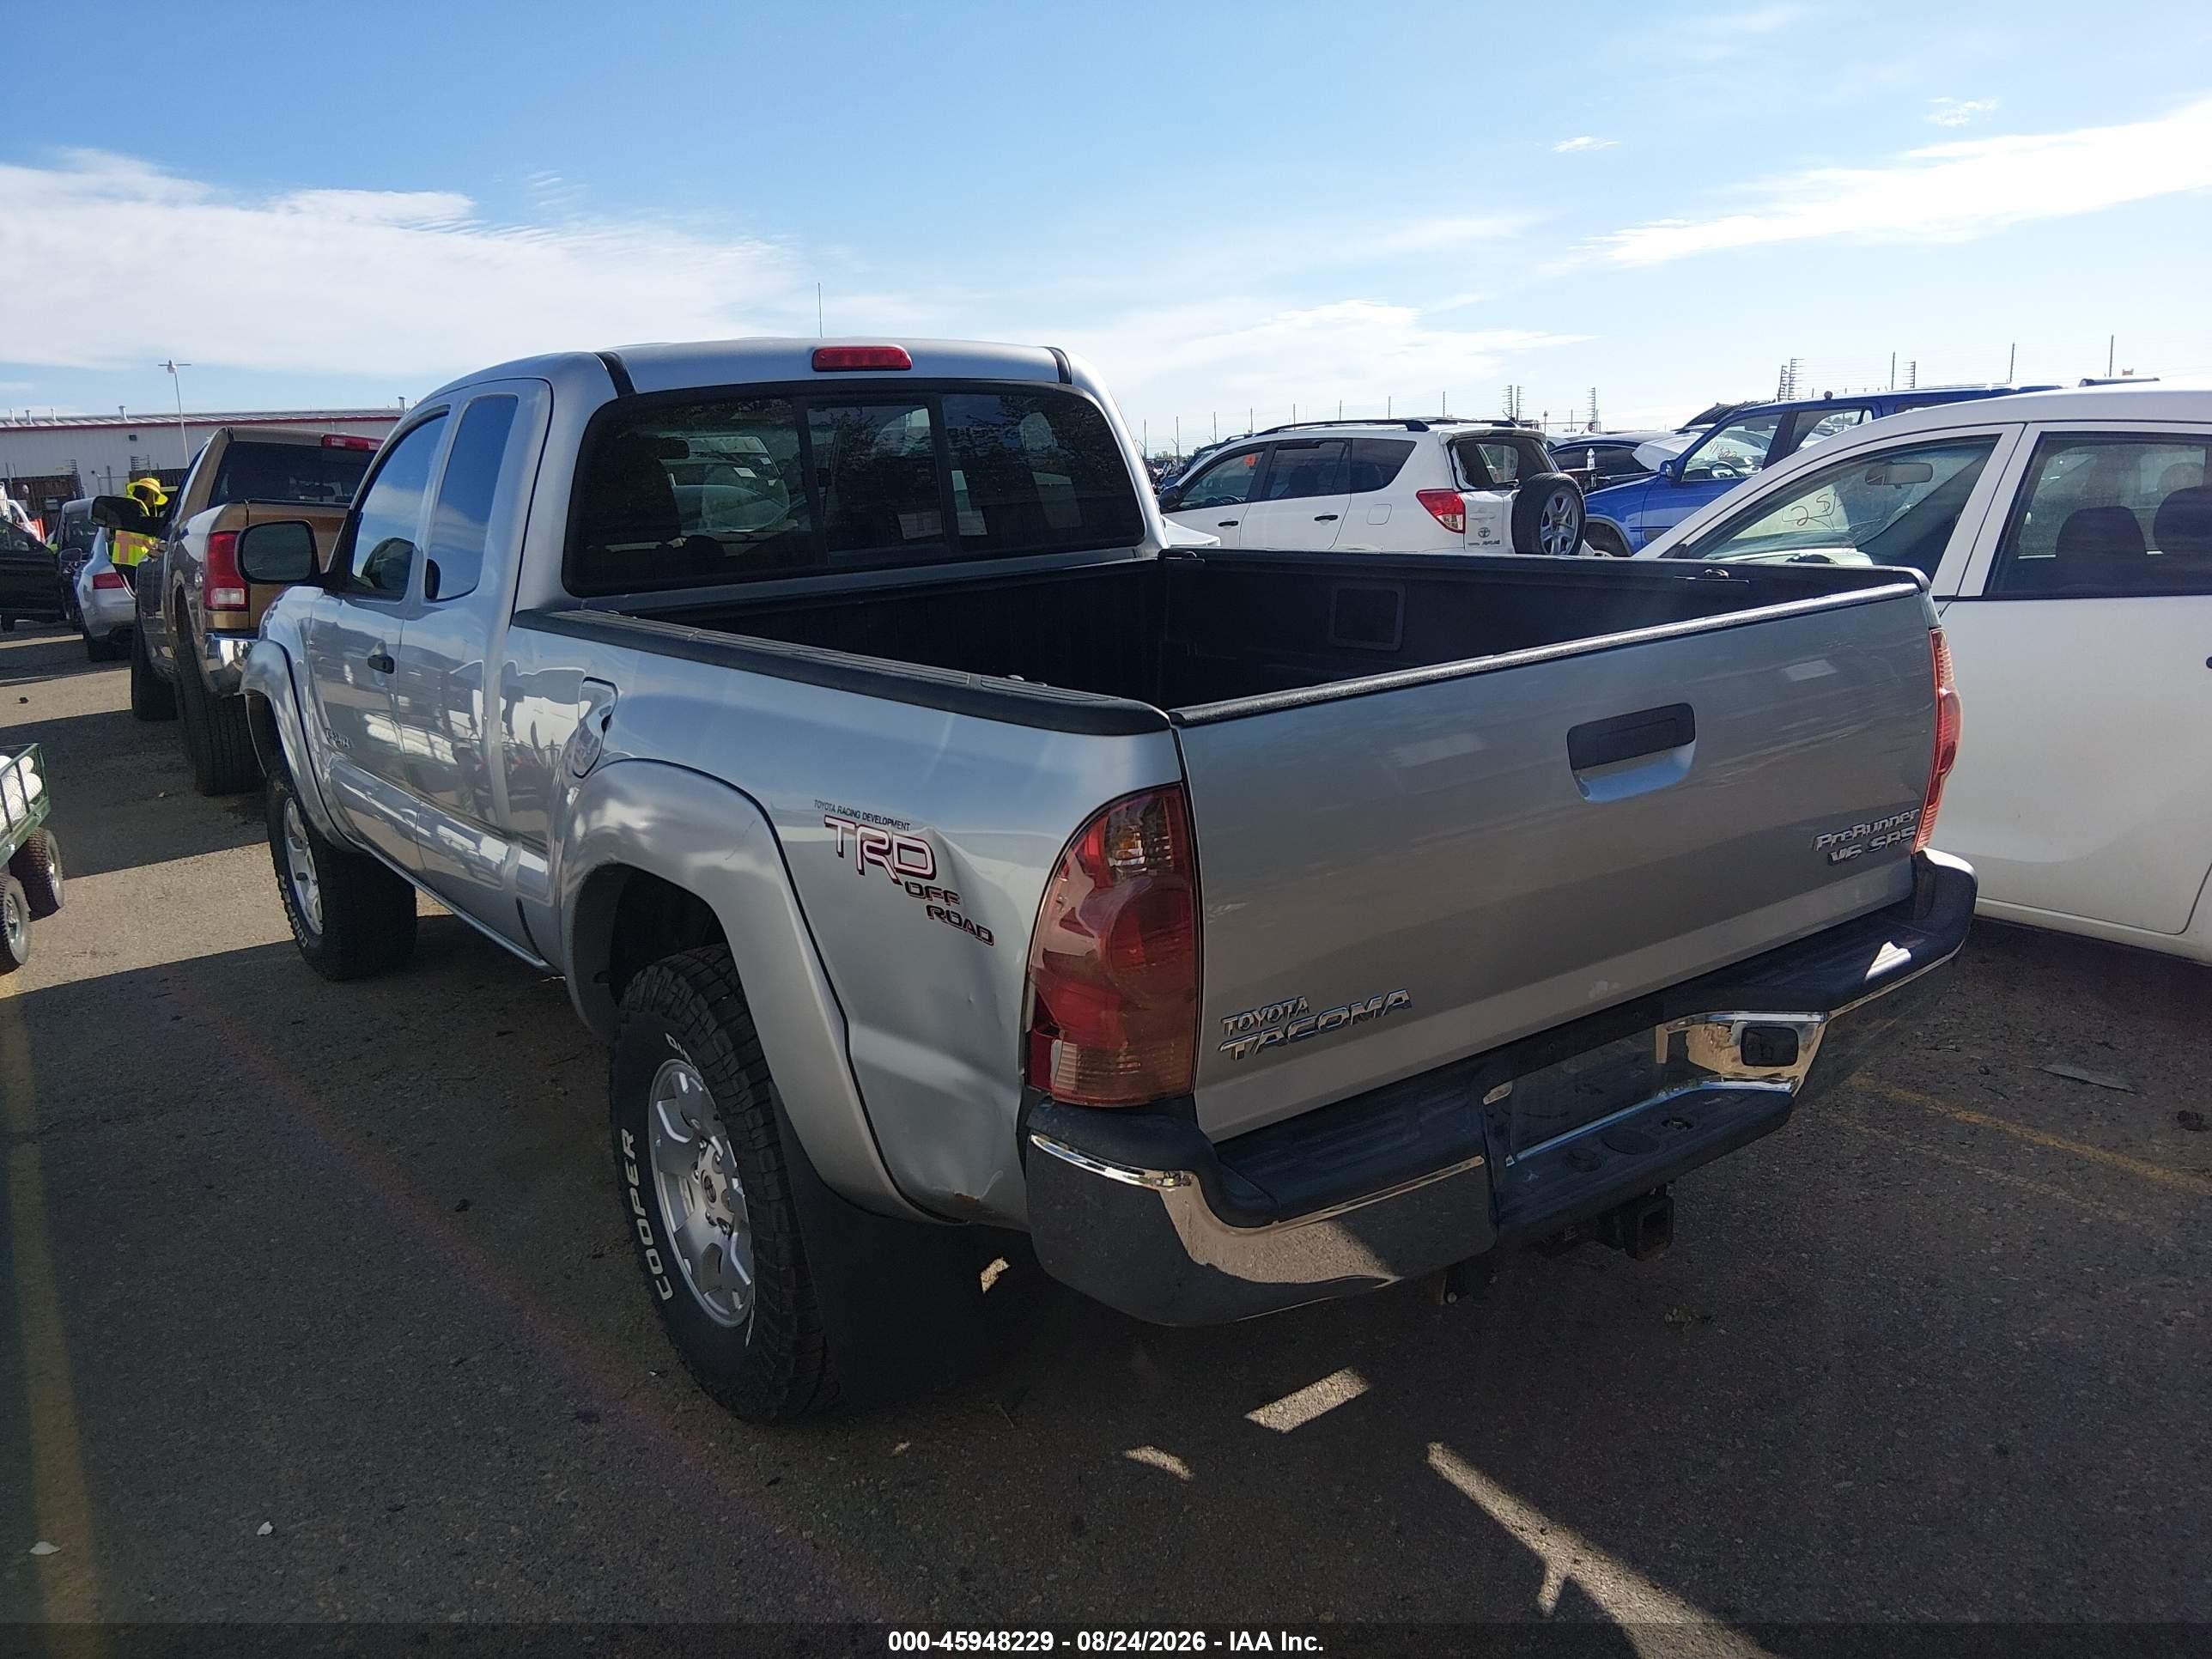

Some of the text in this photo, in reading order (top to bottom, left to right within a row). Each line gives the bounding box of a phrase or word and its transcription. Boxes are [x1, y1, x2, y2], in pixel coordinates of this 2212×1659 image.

[814, 799, 911, 831] TOYOTA RACING DEVELOPMENT
[1813, 808, 1920, 852] PreRunner
[823, 814, 937, 885] TRD
[1828, 825, 1916, 866] V6 SR5
[904, 880, 961, 906] OFF
[926, 904, 994, 946] ROAD
[1218, 988, 1413, 1061] TACOMA
[1221, 996, 1310, 1036] TOYOTA
[621, 1127, 673, 1301] COOPER
